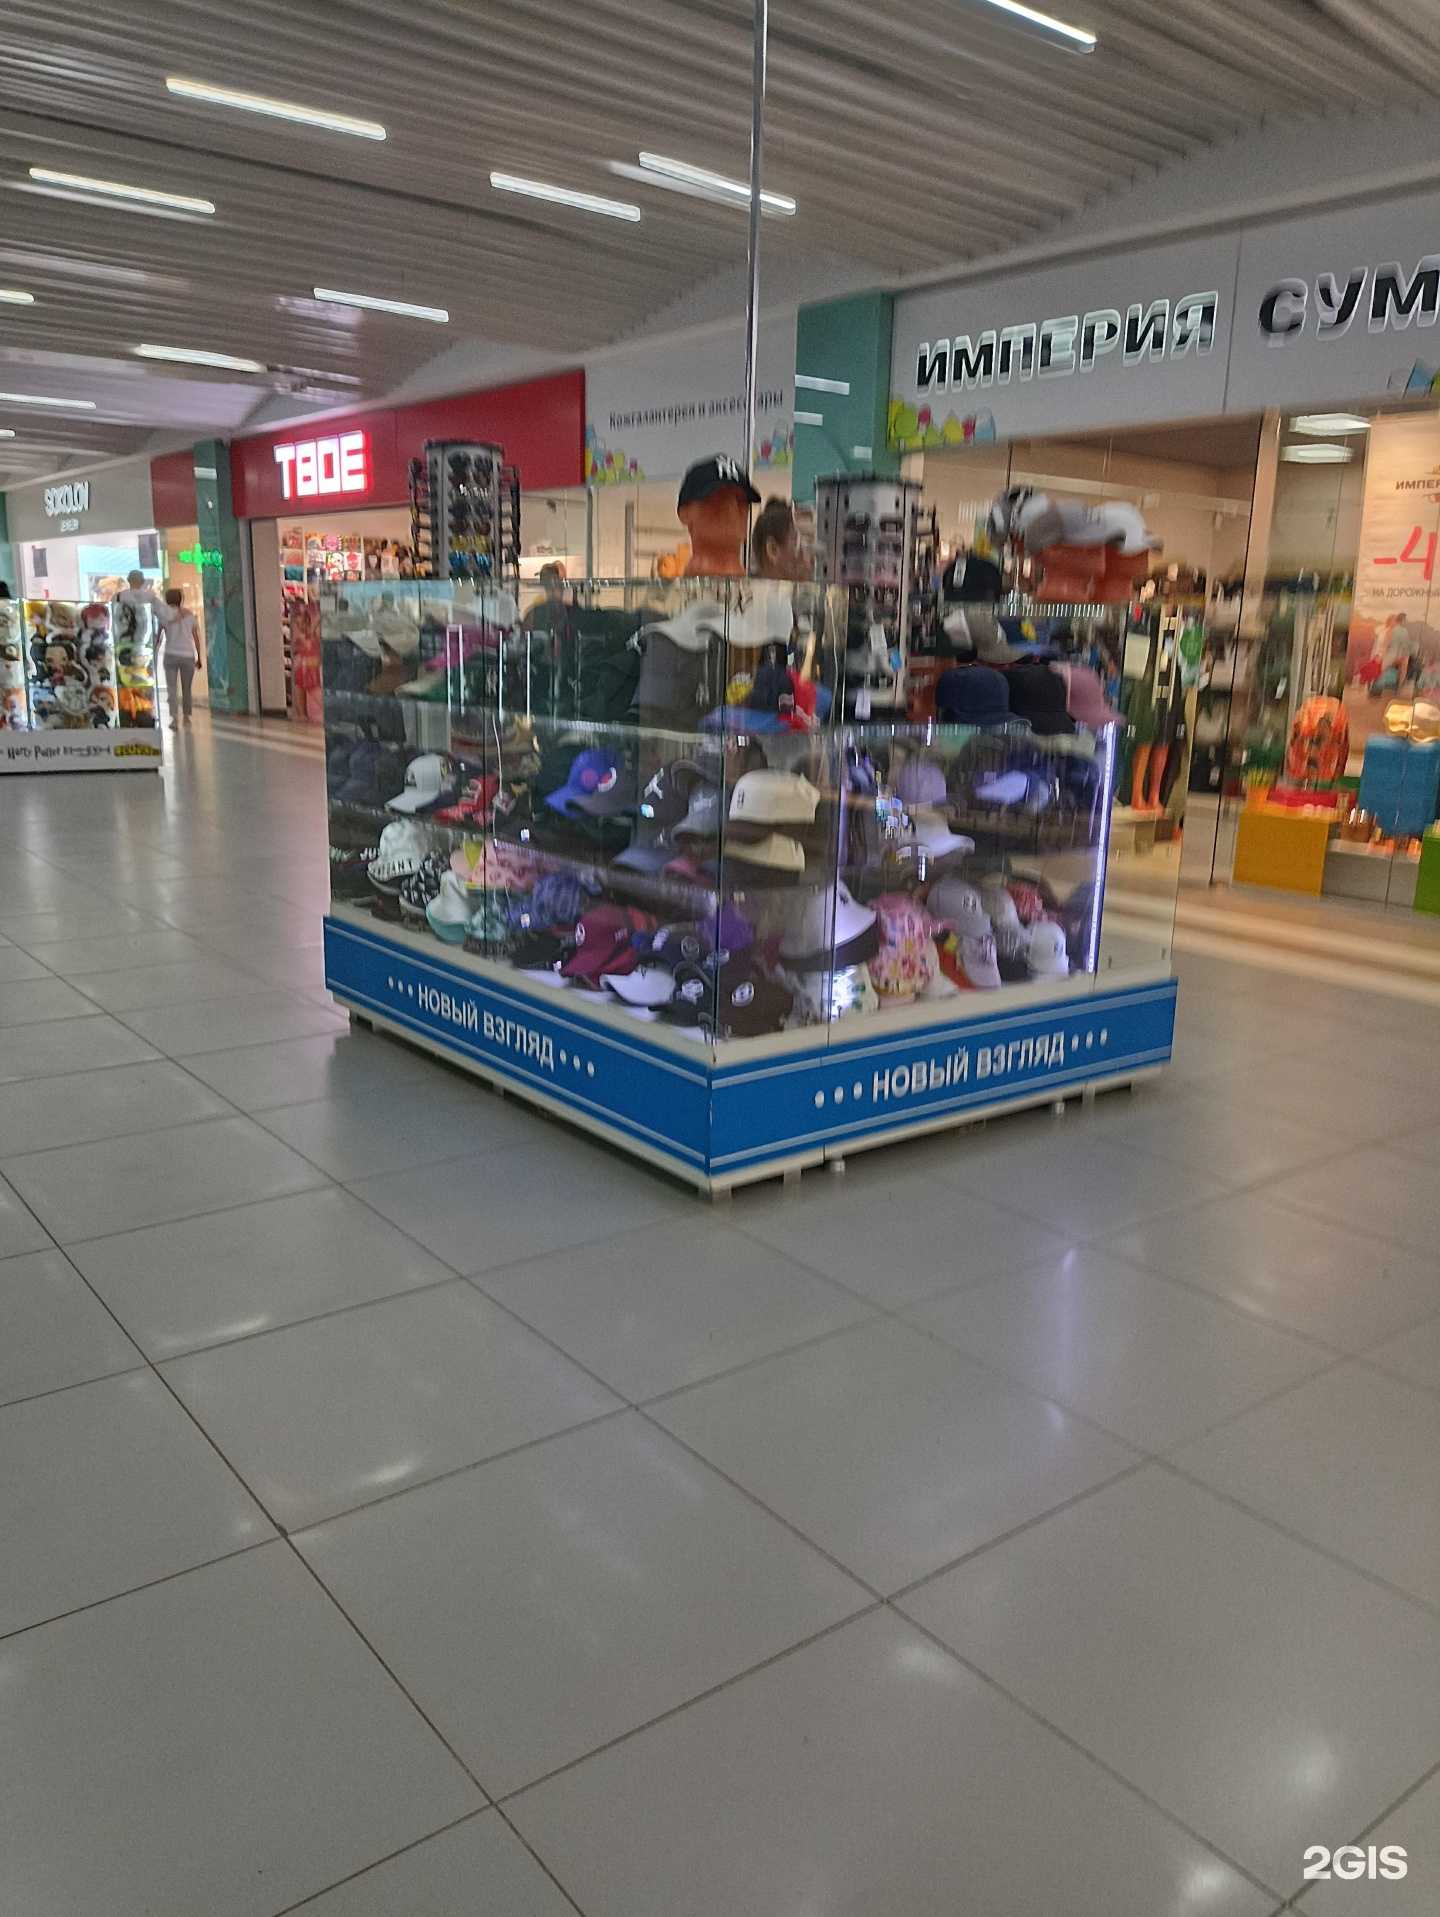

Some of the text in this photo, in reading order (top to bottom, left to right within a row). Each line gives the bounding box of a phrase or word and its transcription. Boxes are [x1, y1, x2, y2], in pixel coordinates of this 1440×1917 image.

[916, 290, 1219, 398] ИМПЕРИЯ
[273, 430, 366, 500] ТВОЕ
[418, 983, 555, 1073] НОВЫЙ ВЗГЛЯД
[872, 1031, 1065, 1103] НОВЫЙ ВЗГЛЯД
